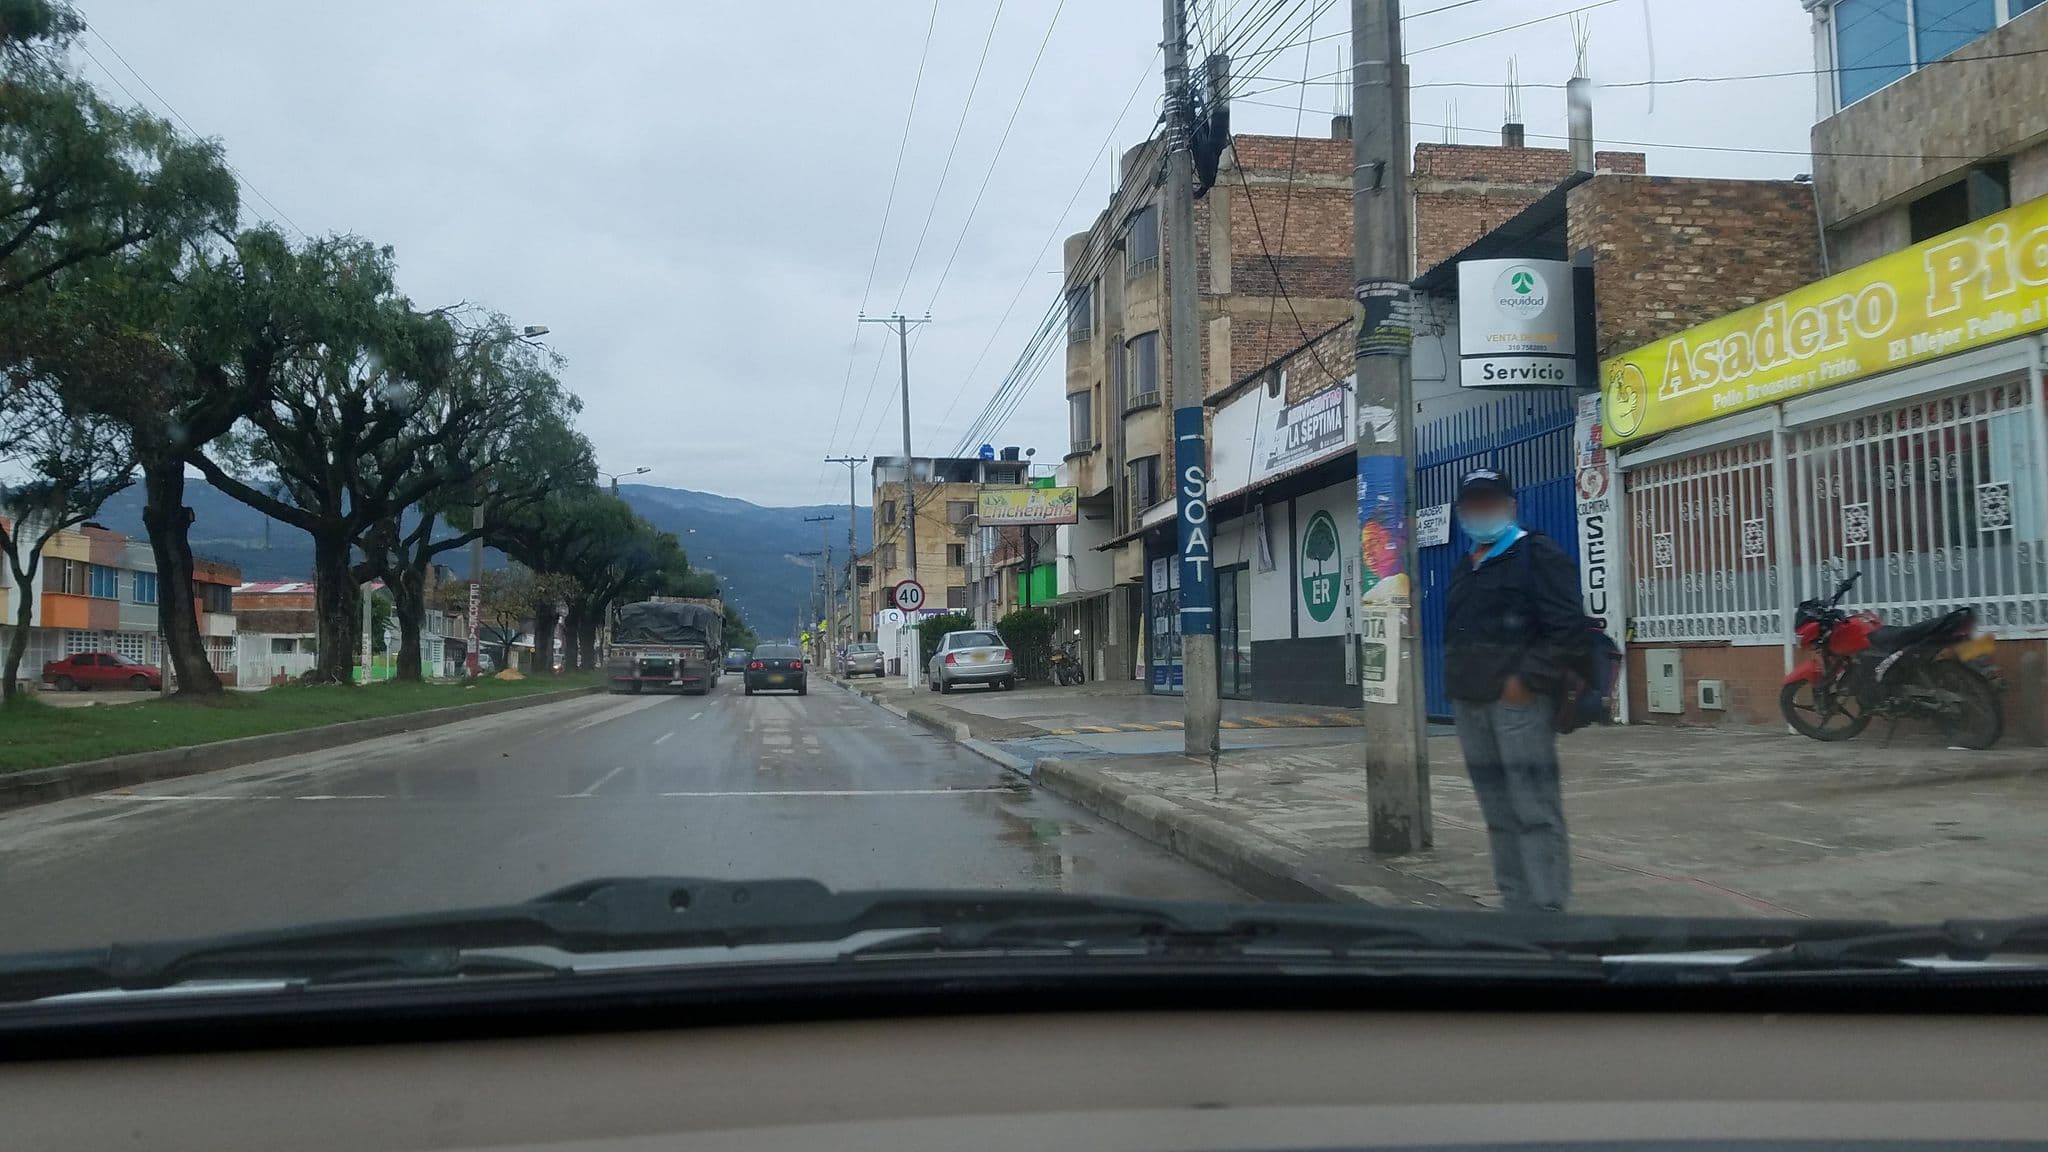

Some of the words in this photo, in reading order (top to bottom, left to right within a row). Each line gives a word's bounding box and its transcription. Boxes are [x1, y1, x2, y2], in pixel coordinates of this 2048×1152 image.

[1499, 296, 1545, 307] equidad
[1658, 282, 1898, 401] Asadero
[1888, 338, 1908, 362] El
[1911, 328, 1964, 356] Mejor
[1483, 363, 1565, 381] Servicio
[1712, 389, 1744, 411] Pollo
[1807, 370, 1816, 390] y
[1287, 423, 1300, 450] LA
[1301, 405, 1343, 444] SEPTIMA
[1183, 465, 1209, 583] SOAT
[899, 588, 919, 604] 40
[1312, 578, 1331, 605] ER
